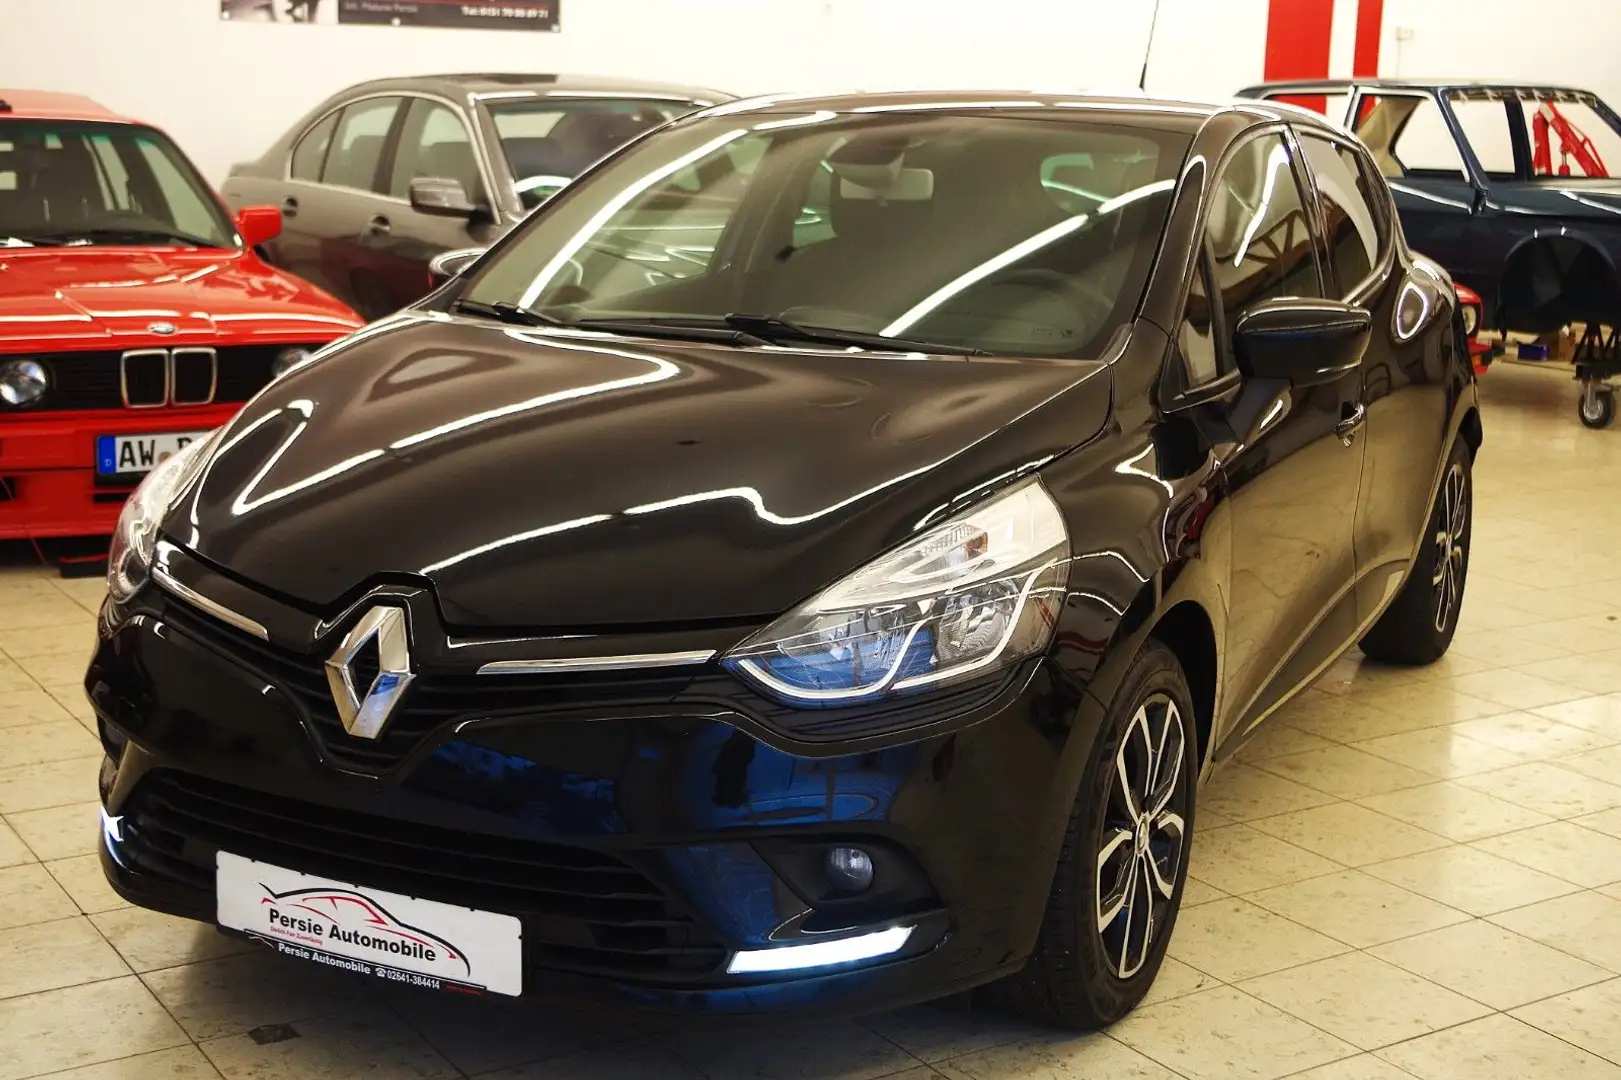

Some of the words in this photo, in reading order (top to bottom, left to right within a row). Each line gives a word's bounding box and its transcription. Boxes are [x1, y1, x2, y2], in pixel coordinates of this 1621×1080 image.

[269, 908, 323, 936] Persie
[329, 924, 436, 961] Automobile
[278, 942, 310, 960] Persie
[311, 952, 371, 975] Automobile
[386, 970, 440, 990] 02641-384414
